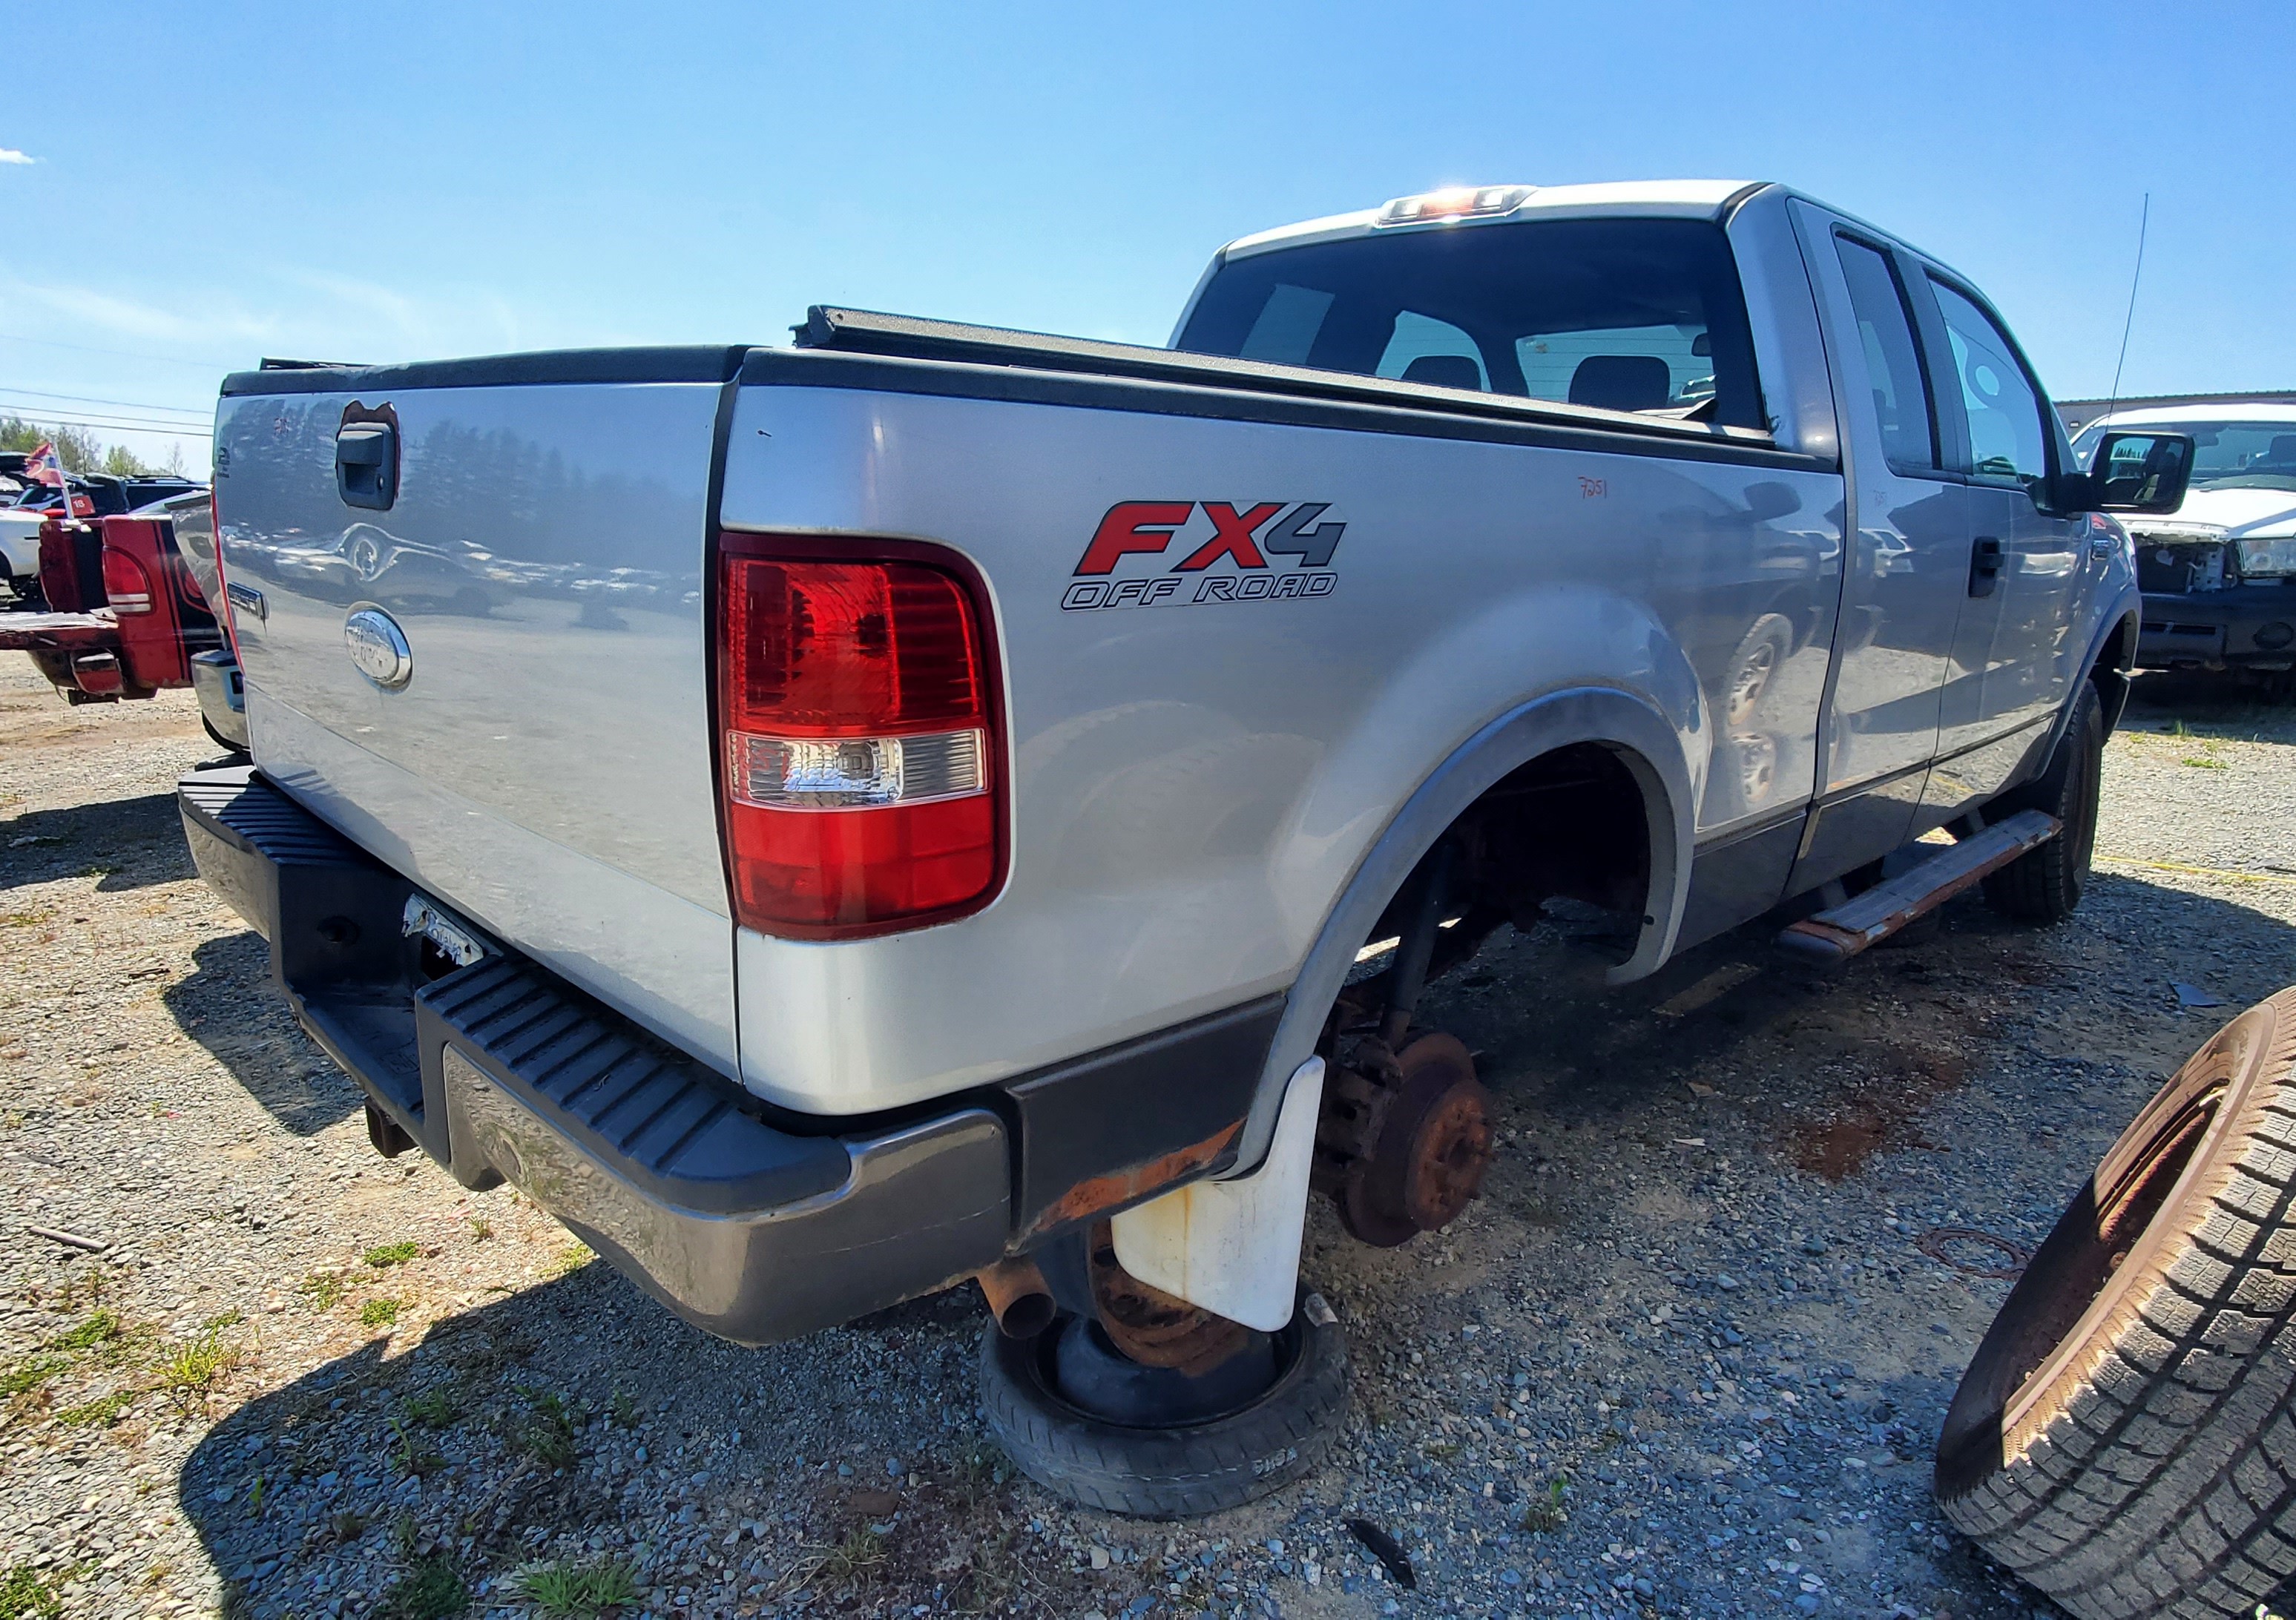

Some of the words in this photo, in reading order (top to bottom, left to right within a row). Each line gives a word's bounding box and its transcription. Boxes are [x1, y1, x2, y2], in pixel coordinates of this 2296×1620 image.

[1072, 501, 1348, 576] FX4
[1061, 577, 1183, 610] OFF
[1192, 572, 1338, 602] ROAD
